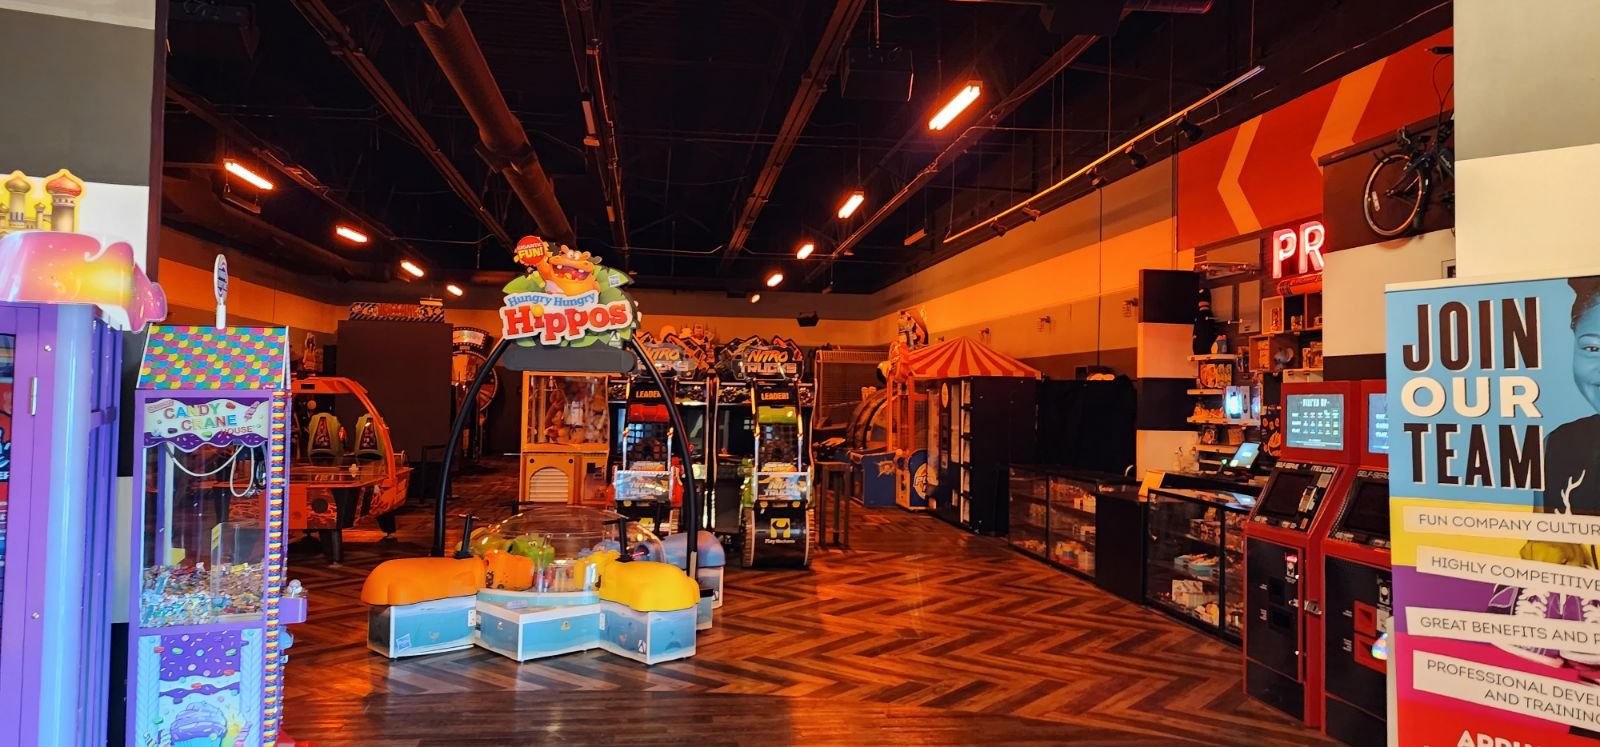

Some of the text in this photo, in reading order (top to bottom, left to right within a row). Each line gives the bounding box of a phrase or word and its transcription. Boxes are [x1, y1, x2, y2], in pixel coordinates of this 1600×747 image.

[518, 248, 544, 259] FUN!
[508, 293, 595, 308] Hungry Hungry
[504, 303, 628, 341] Hippos
[1402, 296, 1542, 373] JOIN
[747, 350, 789, 363] NITRO
[740, 362, 797, 374] TRUCKS
[1400, 376, 1543, 418] OUR
[164, 402, 221, 420] CANDY
[181, 414, 238, 431] CRANE
[220, 425, 253, 435] HOUSE
[1403, 423, 1546, 492] TEAM
[1419, 513, 1600, 536] FUN COMPANY CULTUR
[1431, 556, 1600, 592] HIGHLY COMPETITIVE
[1420, 616, 1468, 632] GREAT
[1472, 621, 1548, 640] BENEFITS
[1552, 629, 1588, 644] AND
[1427, 659, 1548, 696] PROFESSIONAL
[1484, 689, 1520, 705] AND
